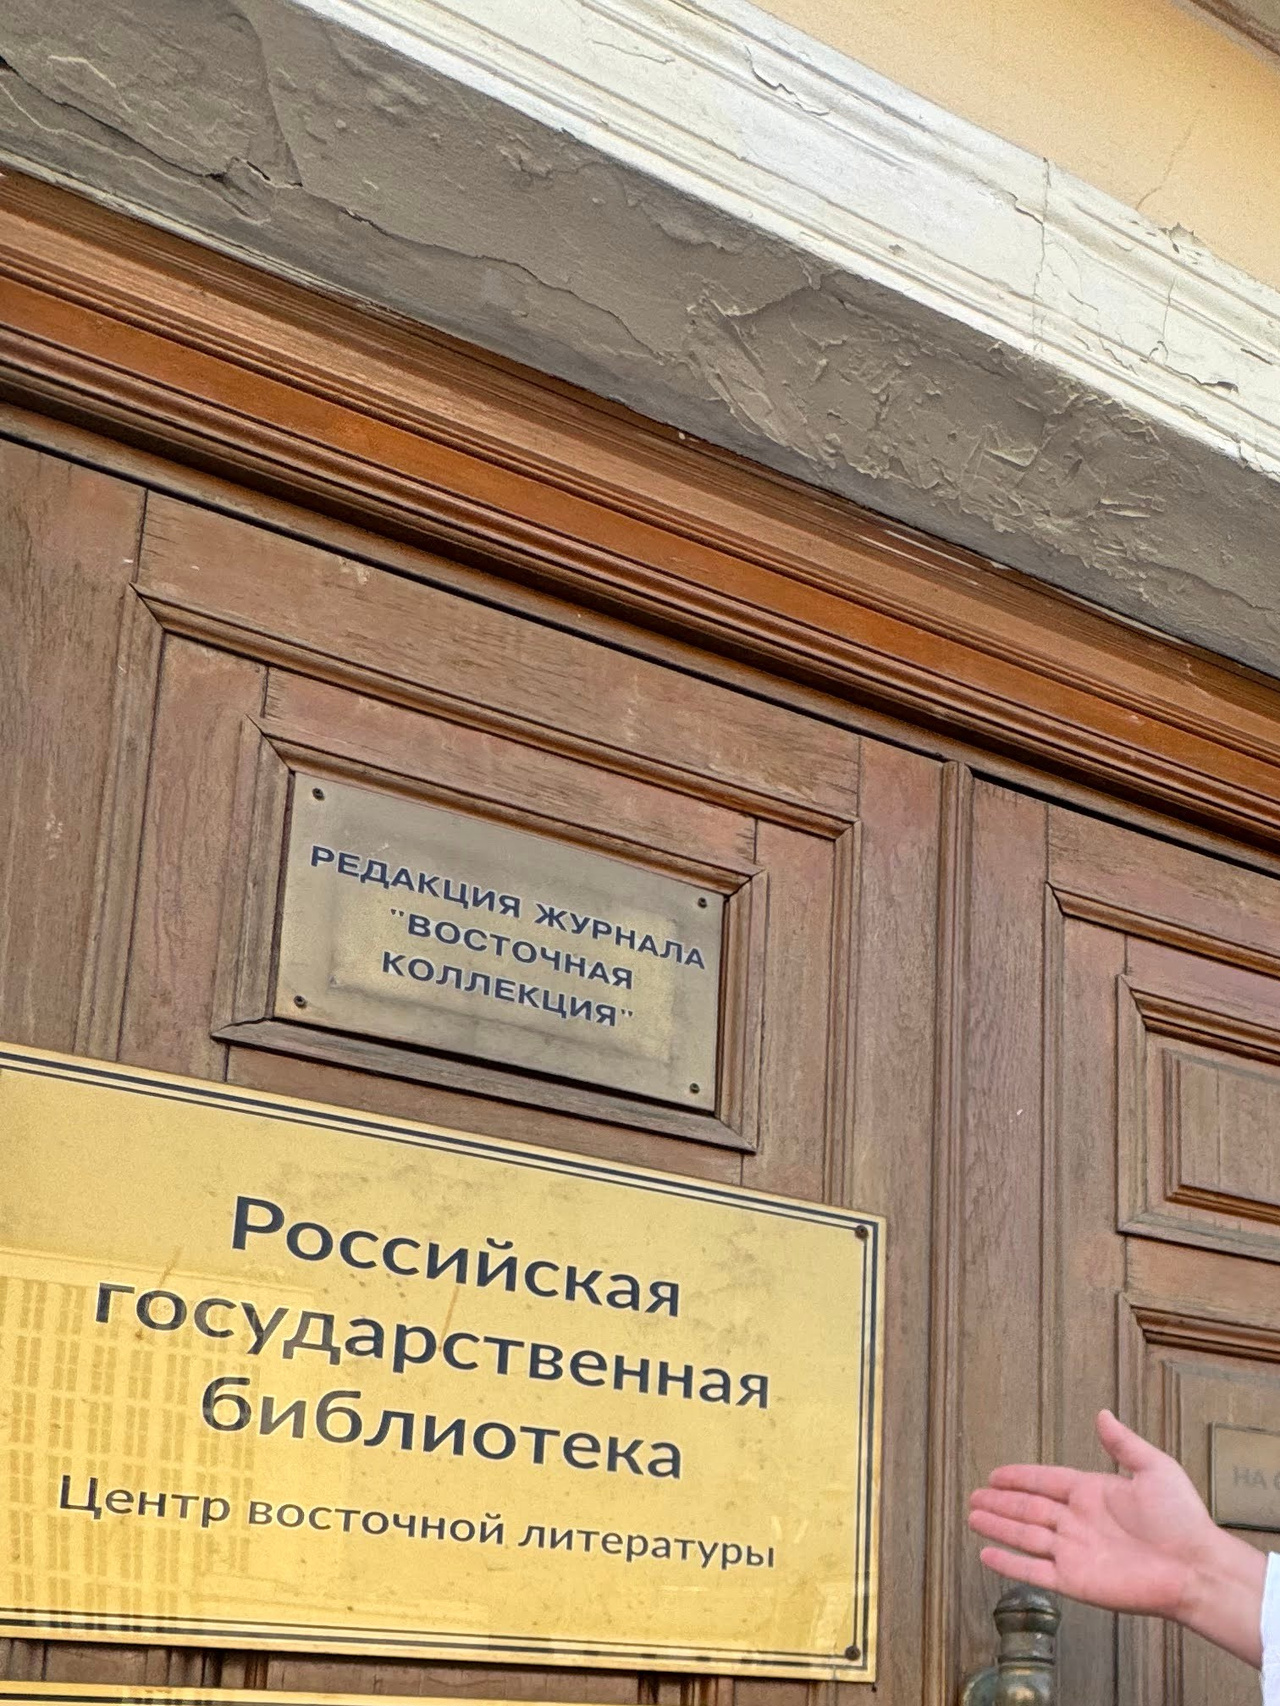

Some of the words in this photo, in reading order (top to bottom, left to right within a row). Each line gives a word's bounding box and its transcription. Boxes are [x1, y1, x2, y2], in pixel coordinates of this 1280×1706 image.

[311, 845, 521, 918] РЕДАКЦИЯ
[534, 903, 706, 970] ЖУРНАЛА
[390, 908, 633, 990] "ВОСТОЧНАЯ
[382, 951, 634, 1027] КОЛЛЕКЦИЯ"
[231, 1195, 682, 1317] Российская
[94, 1282, 771, 1409] государственная
[201, 1376, 683, 1480] библиотека
[59, 1474, 231, 1528] Центр
[248, 1495, 506, 1547] восточной
[517, 1524, 776, 1570] литературы
